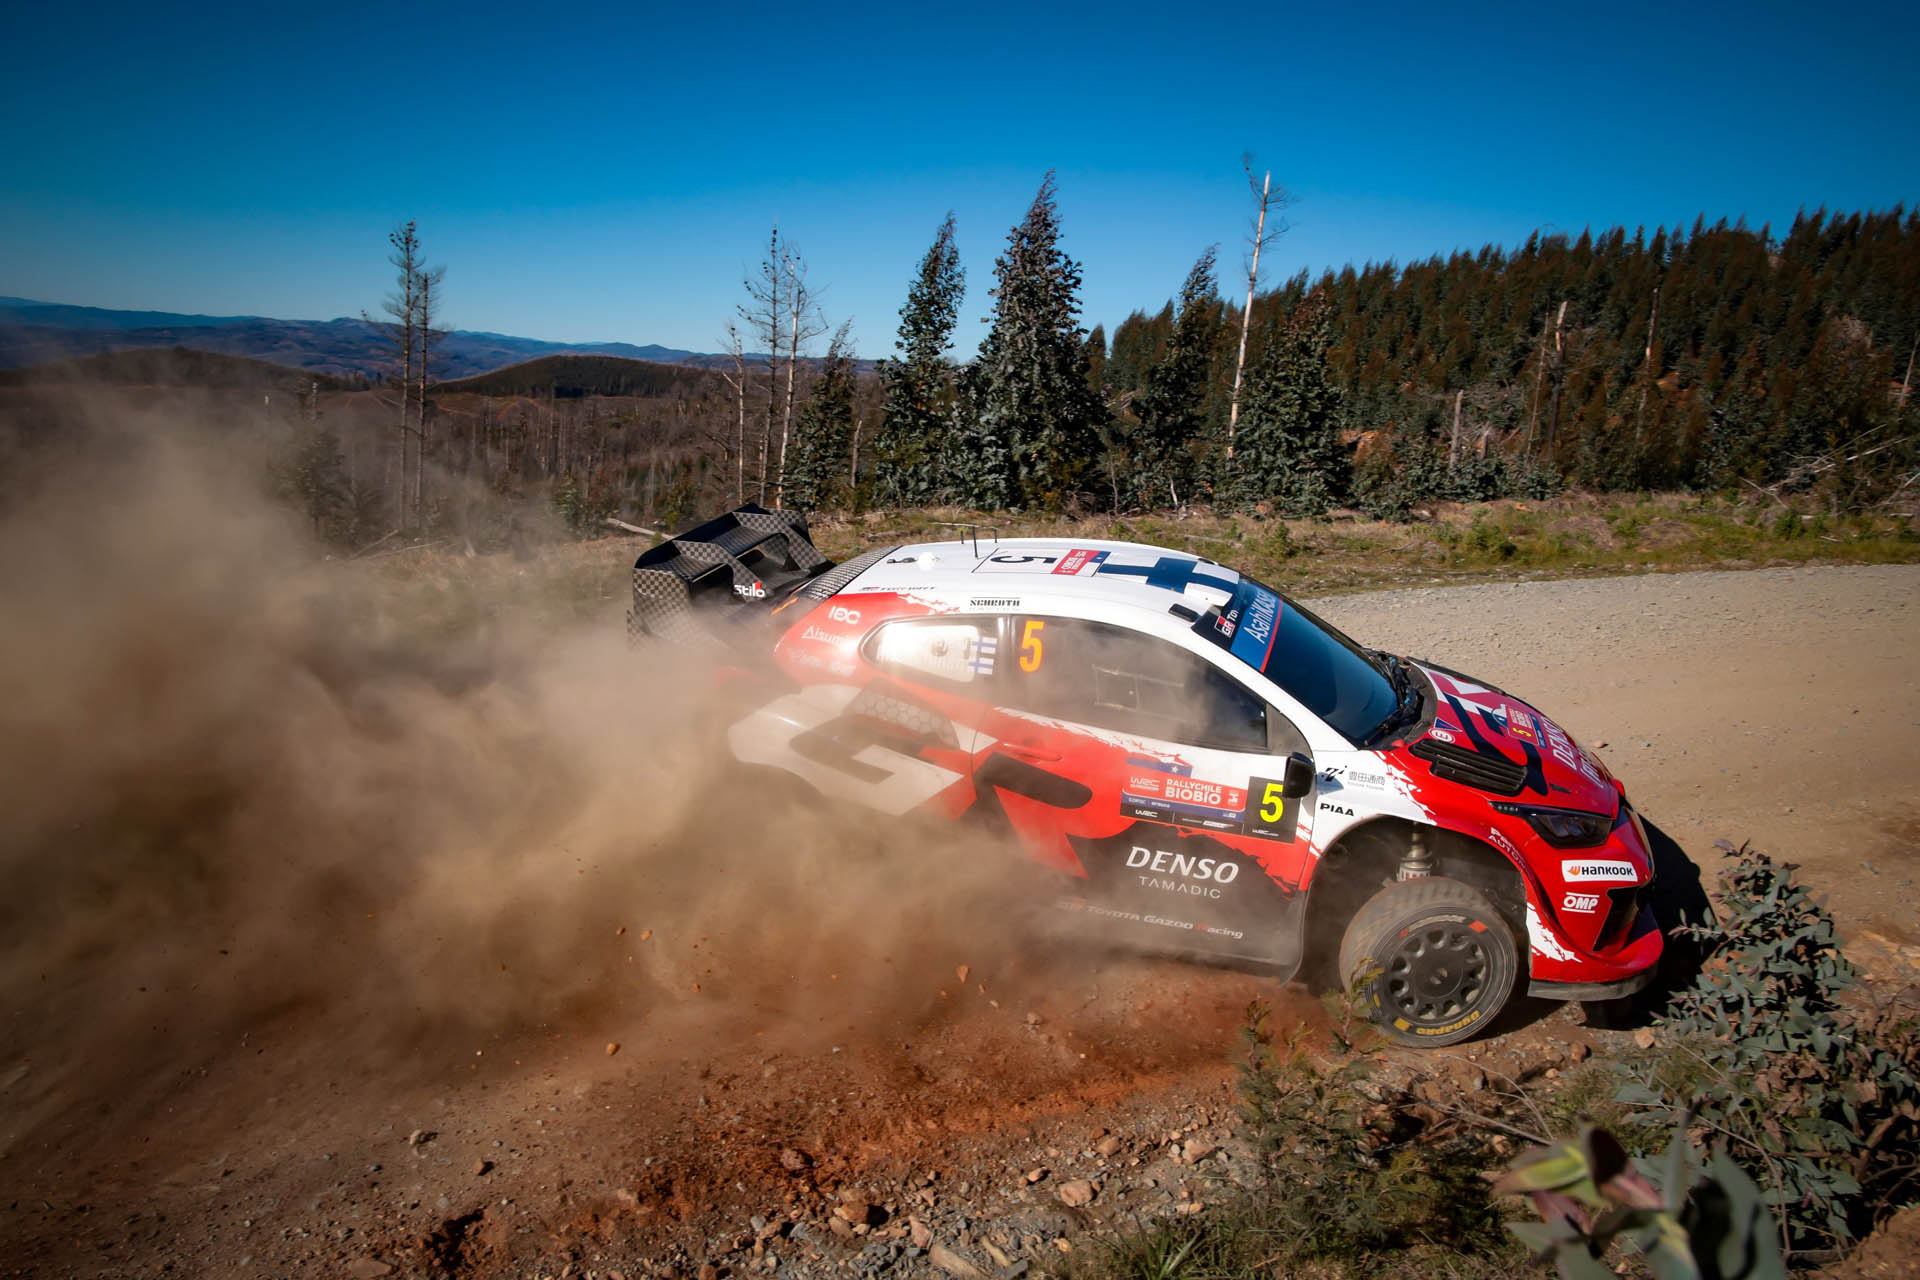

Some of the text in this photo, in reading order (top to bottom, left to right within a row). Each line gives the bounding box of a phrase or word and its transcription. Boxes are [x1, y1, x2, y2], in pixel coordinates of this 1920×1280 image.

[734, 580, 766, 598] Stilo
[1019, 620, 1045, 672] 5
[1259, 782, 1284, 824] 5
[1320, 803, 1354, 816] PIAA
[1126, 846, 1239, 884] DENSO
[1139, 876, 1221, 899] TAMADIC
[1563, 895, 1599, 910] OMP
